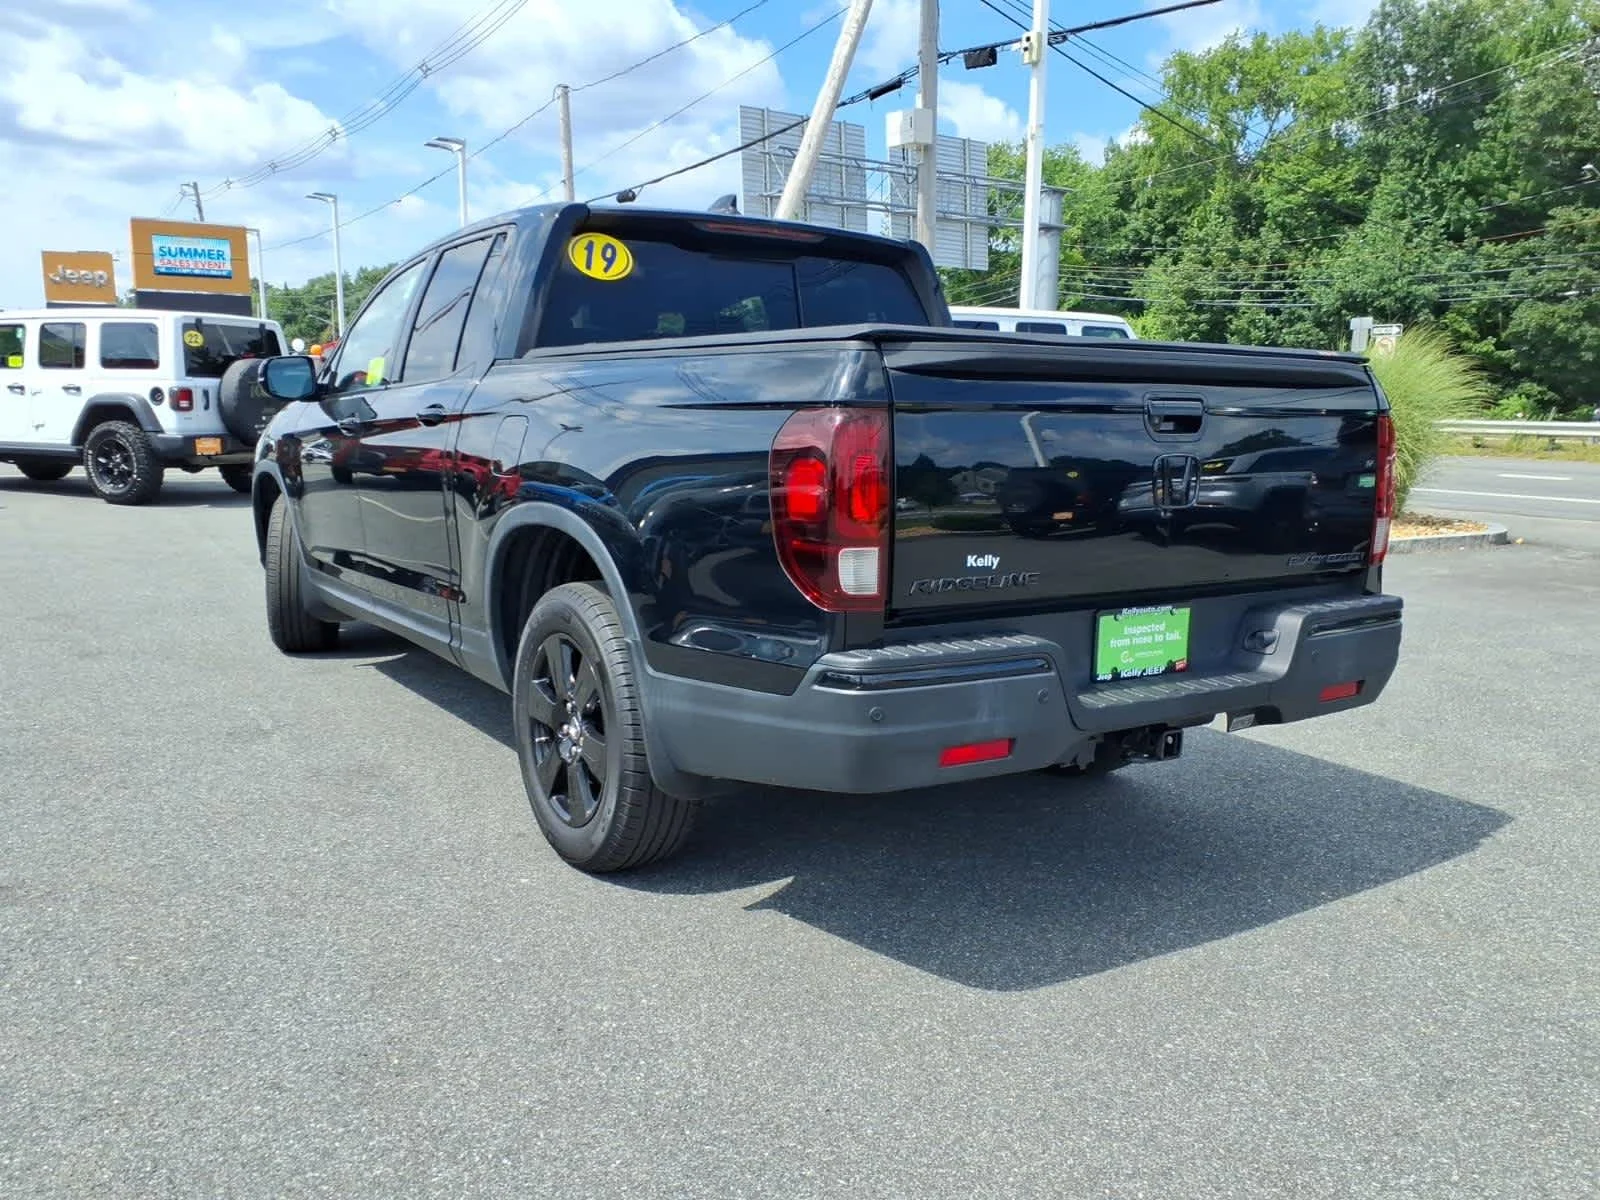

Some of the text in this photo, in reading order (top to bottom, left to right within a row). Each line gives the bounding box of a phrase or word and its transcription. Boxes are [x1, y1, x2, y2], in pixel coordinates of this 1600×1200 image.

[159, 246, 226, 261] SUMMER
[584, 240, 617, 273] 19
[160, 259, 191, 267] SALES
[48, 265, 108, 288] Jeep
[967, 554, 1000, 569] Kelly
[909, 572, 1041, 595] RIDGELINE
[1124, 621, 1166, 635] Inspected
[1110, 638, 1130, 648] from
[1155, 633, 1164, 642] to
[1121, 668, 1141, 678] Kelly
[1143, 665, 1165, 676] JEEP
